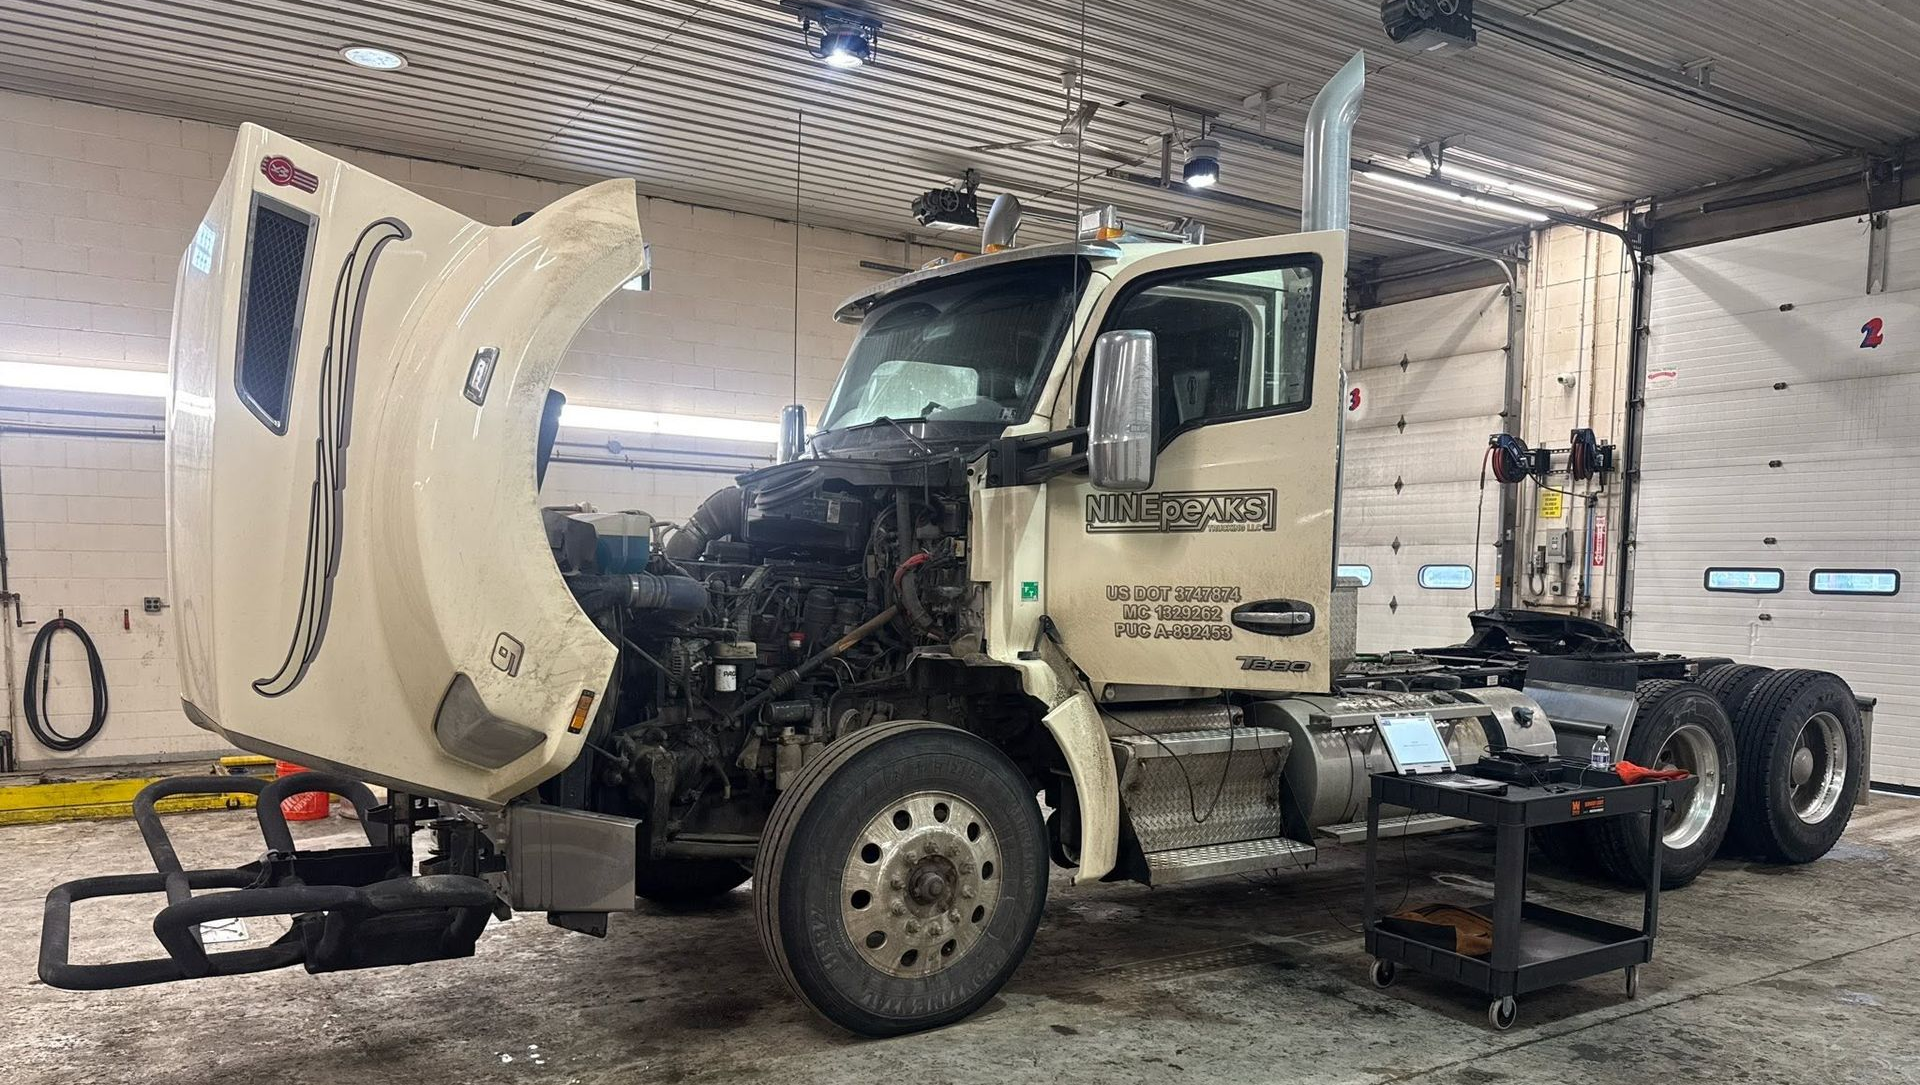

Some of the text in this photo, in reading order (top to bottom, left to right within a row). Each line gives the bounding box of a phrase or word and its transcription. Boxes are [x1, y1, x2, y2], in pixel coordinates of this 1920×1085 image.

[1859, 317, 1884, 349] 2
[1348, 387, 1361, 412] 3
[1247, 524, 1262, 532] LLC
[1106, 585, 1242, 603] US DOT 3747874
[1123, 604, 1222, 622] MC 1329262
[1114, 623, 1233, 641] PUC A-892453
[1235, 655, 1311, 672] T880
